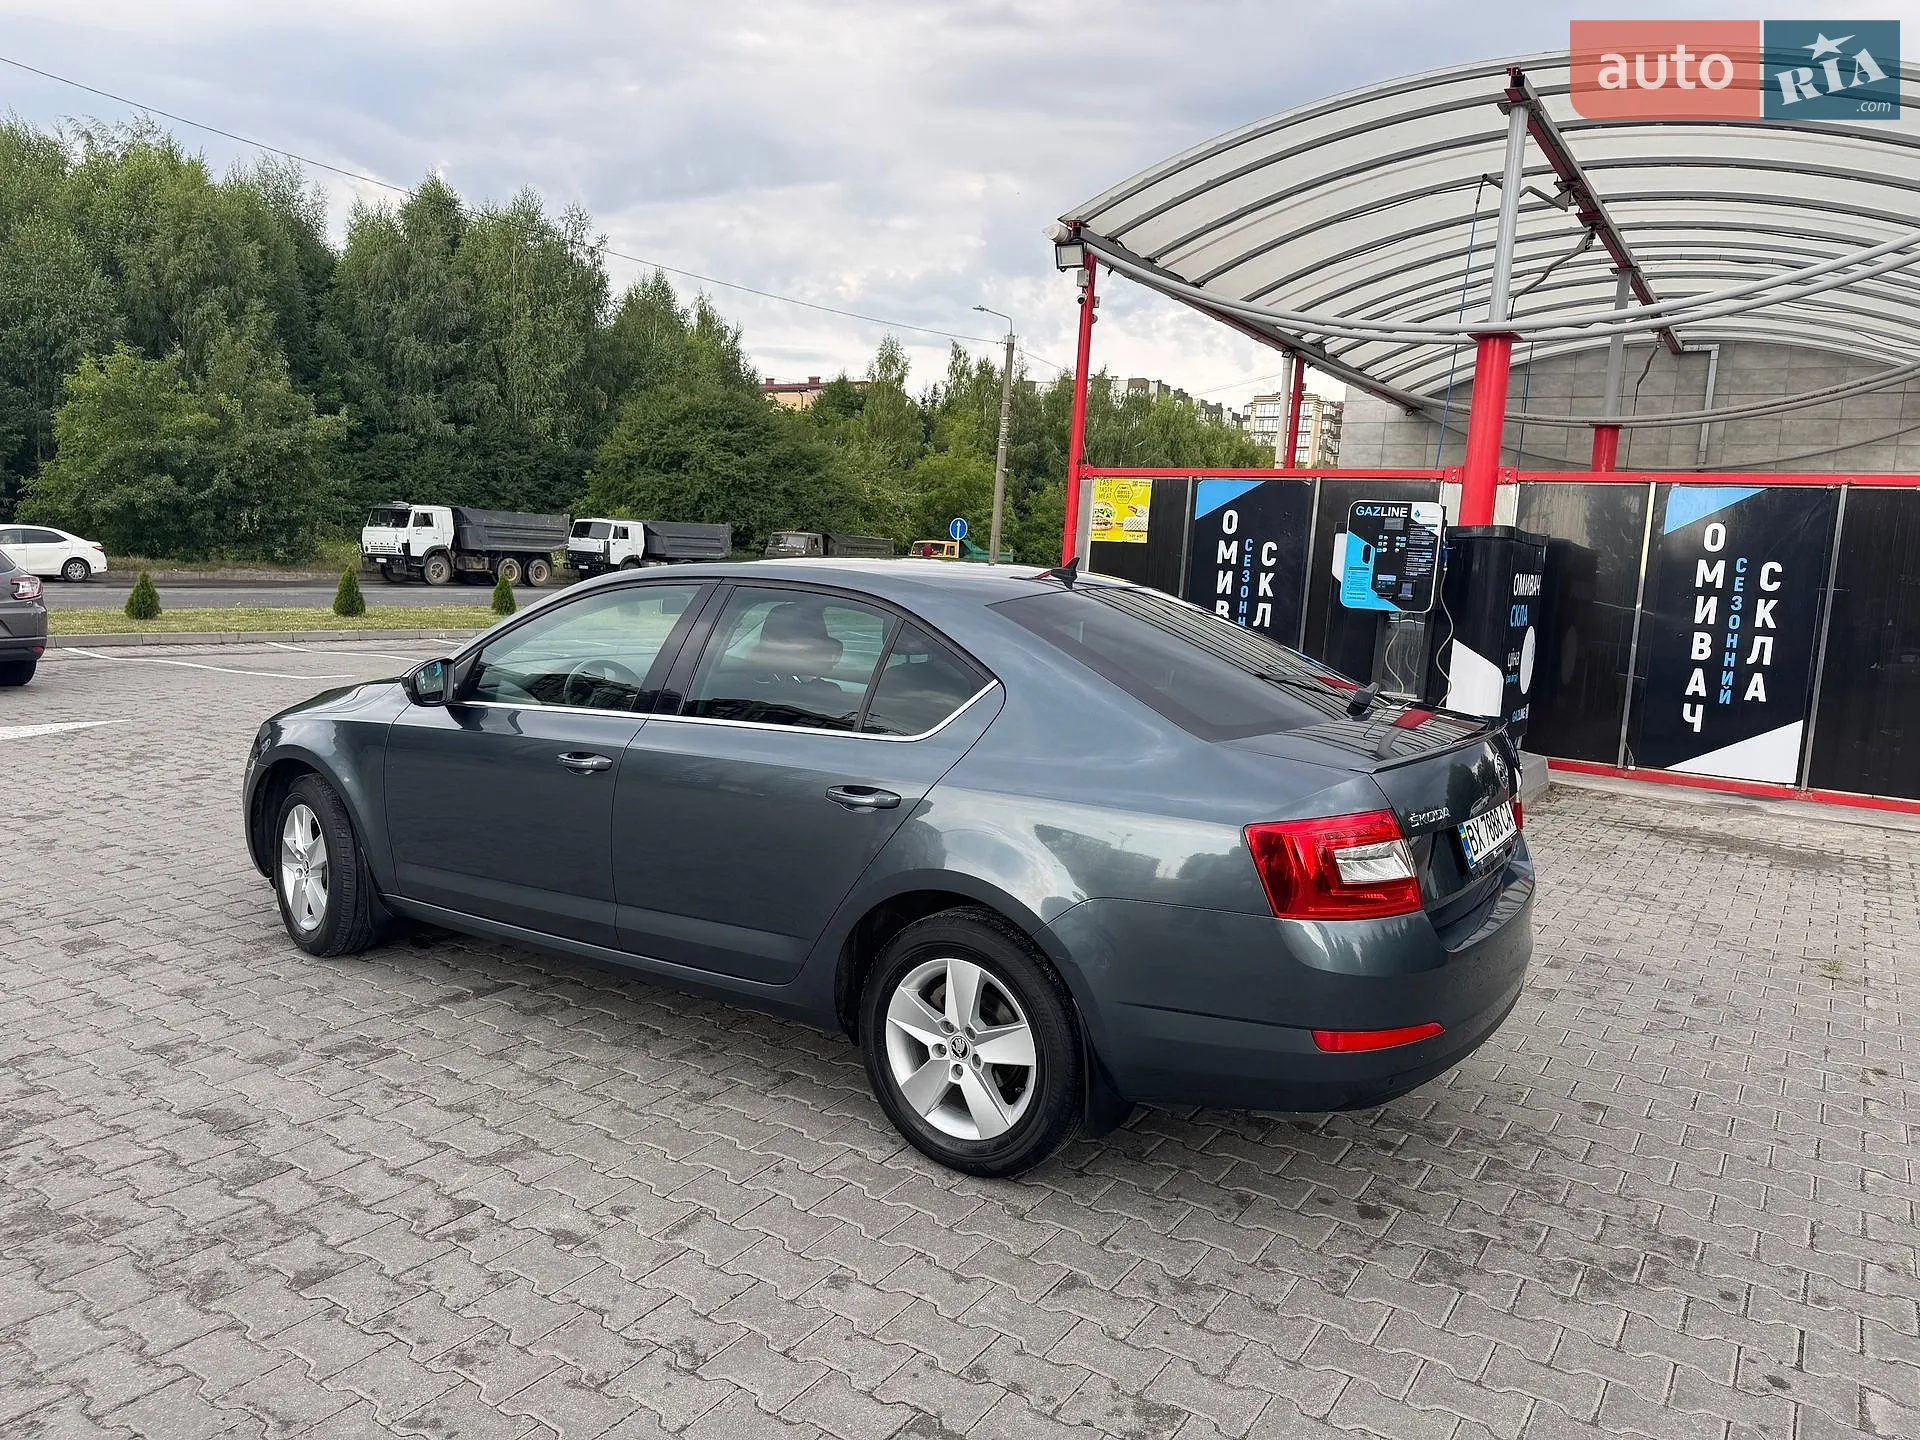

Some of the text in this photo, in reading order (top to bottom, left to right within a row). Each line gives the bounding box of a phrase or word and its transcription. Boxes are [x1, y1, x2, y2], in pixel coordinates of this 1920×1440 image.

[1355, 506, 1409, 517] GAZLINE
[1513, 573, 1542, 597] ОМИВАЧ
[1510, 604, 1529, 627] СКЛА
[1682, 522, 1727, 733] ОМИВАЧ
[1718, 557, 1748, 705] СЕЗОННИЙ
[1743, 561, 1783, 703] СКЛА
[1408, 807, 1451, 828] ŠKODA
[1466, 802, 1515, 856] BX 7888 CA
